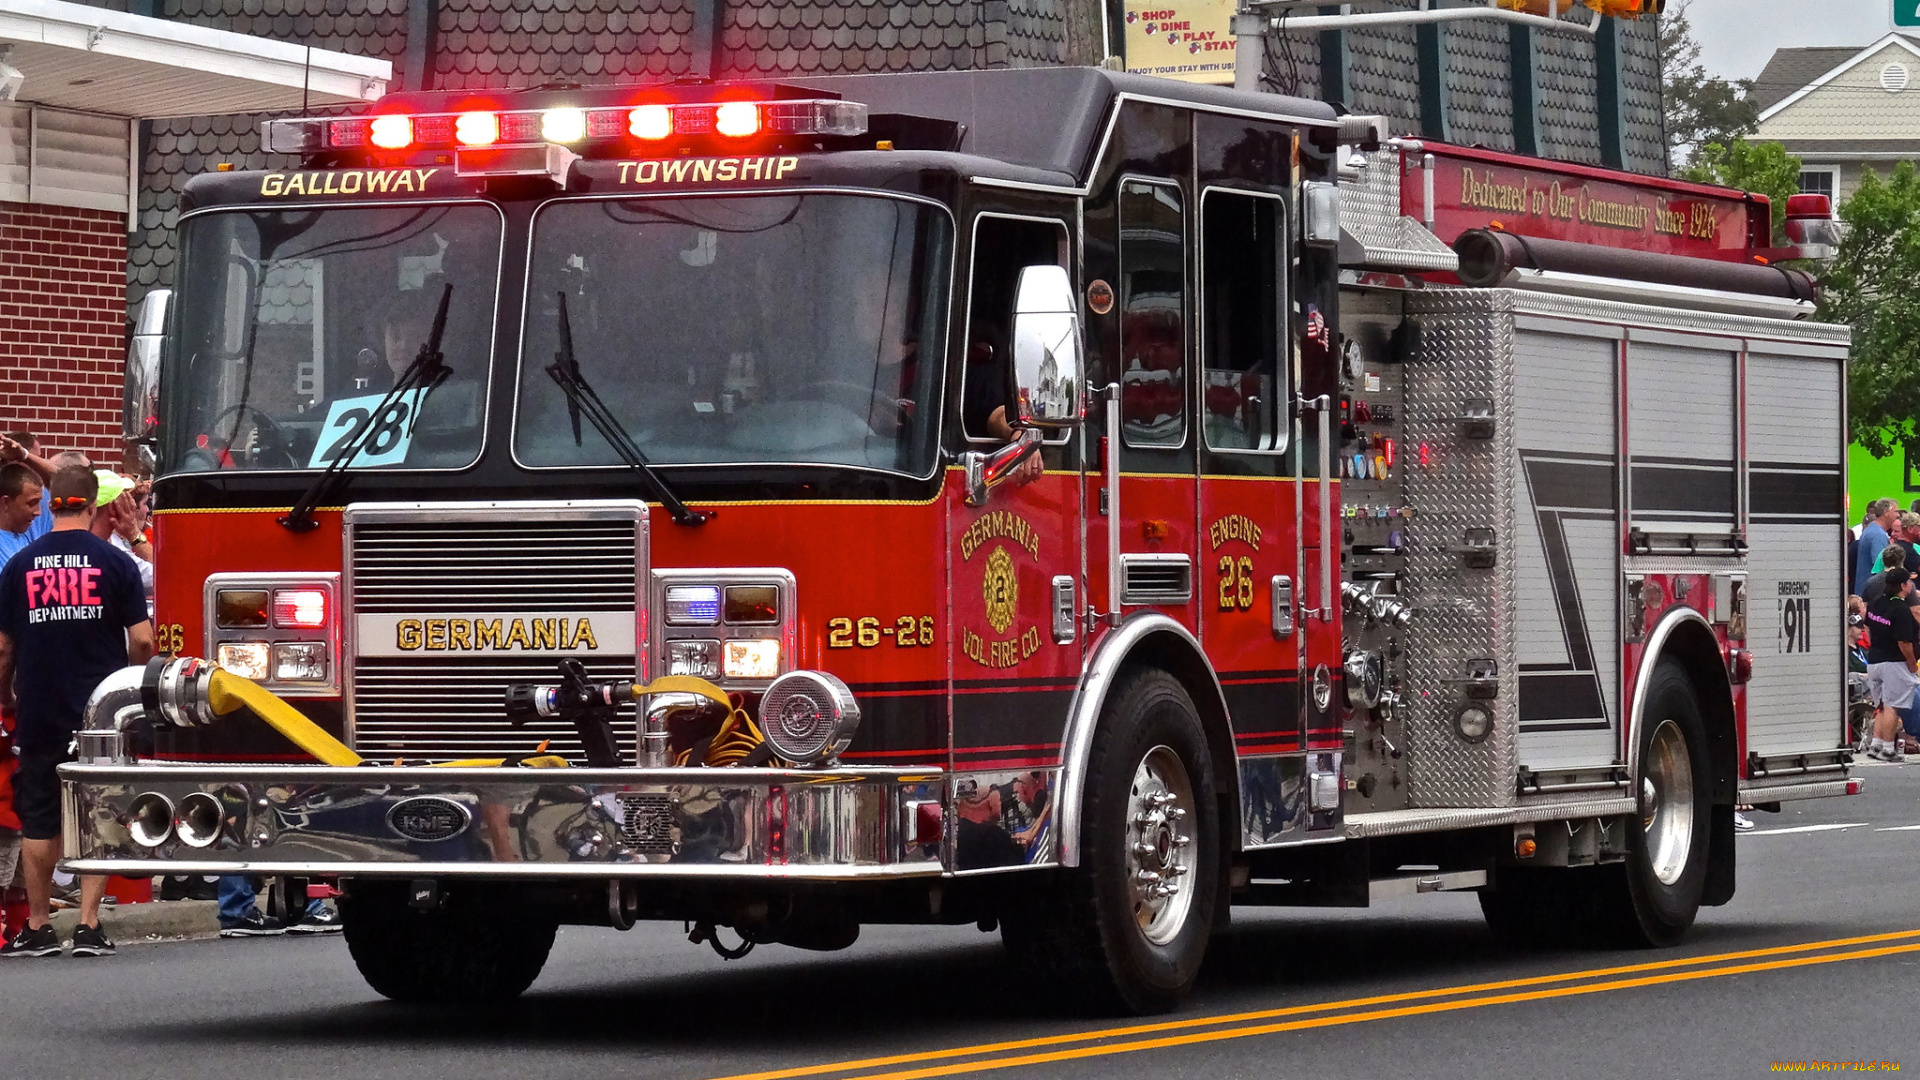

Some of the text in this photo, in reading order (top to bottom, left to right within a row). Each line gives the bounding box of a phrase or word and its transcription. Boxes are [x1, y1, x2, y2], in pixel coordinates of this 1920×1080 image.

[1141, 10, 1176, 21] SHOP
[1161, 21, 1191, 31] DINE
[1183, 31, 1216, 42] PLAY
[1204, 40, 1237, 51] STAY
[1128, 62, 1235, 75] ENJOY YOUR STAY WITH US!
[260, 156, 799, 196] GALLOWAY TOWNSHIP
[1461, 167, 1717, 239] Dedicated to Our Community Since 1926
[319, 401, 410, 463] 28
[960, 510, 1039, 562] GERMANIA
[1209, 514, 1262, 551] ENGINE
[34, 554, 92, 570] PINE HILL
[995, 575, 1005, 603] 2
[1219, 555, 1253, 608] 26
[1778, 581, 1810, 596] EMERGENCY
[28, 605, 104, 624] DEPARTMENT
[1784, 597, 1810, 653] 911
[158, 624, 184, 652] 26
[396, 617, 599, 651] GERMANIA
[828, 615, 934, 648] 26-26
[990, 638, 1019, 668] FIRE
[1021, 625, 1043, 659] CO.
